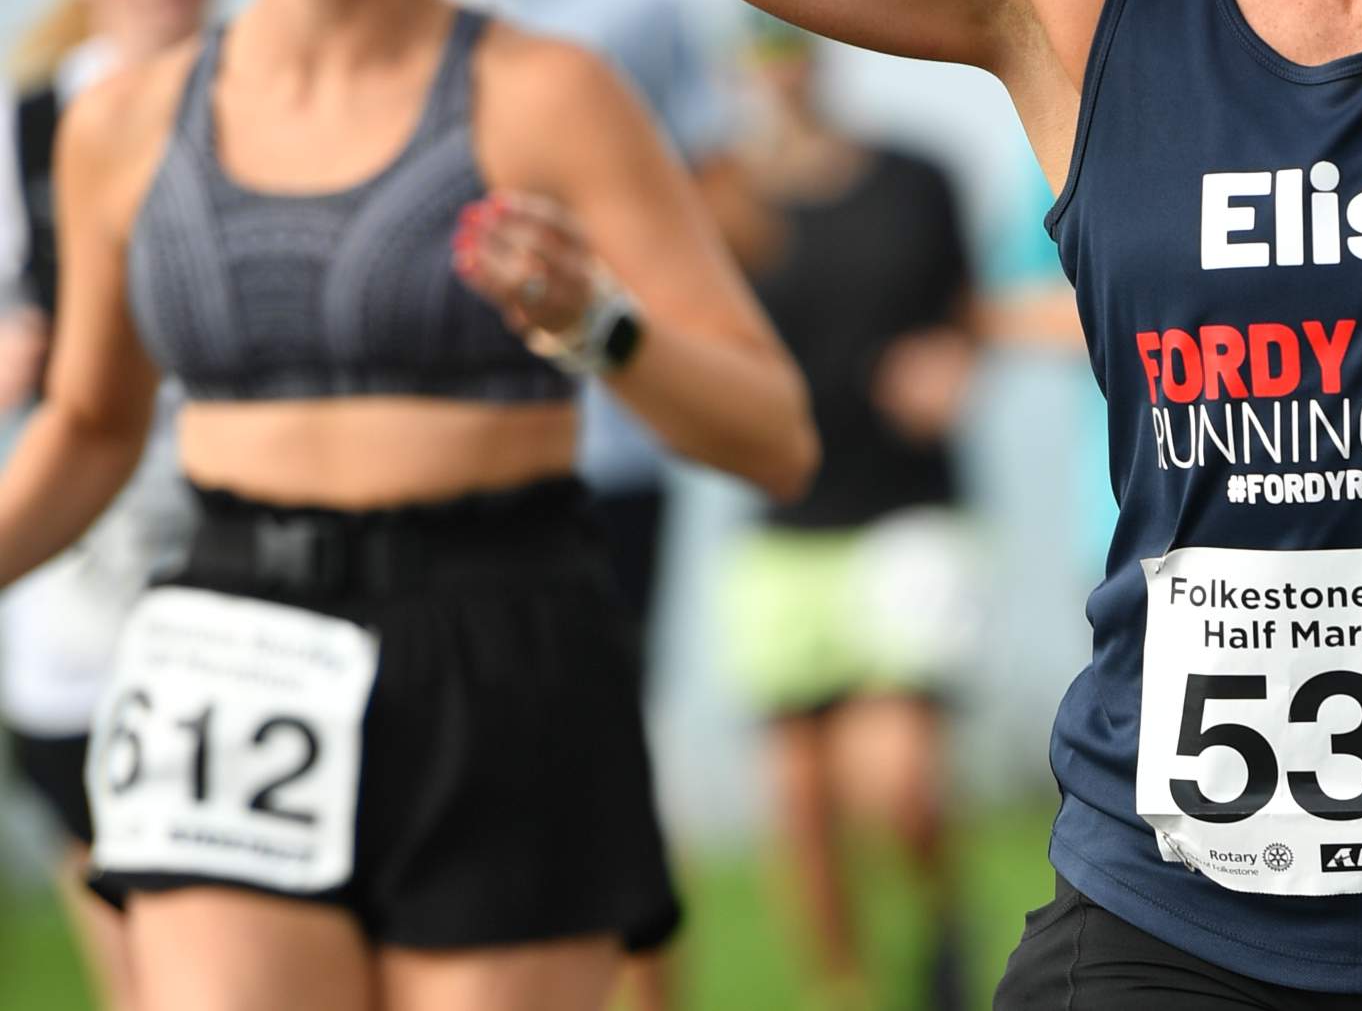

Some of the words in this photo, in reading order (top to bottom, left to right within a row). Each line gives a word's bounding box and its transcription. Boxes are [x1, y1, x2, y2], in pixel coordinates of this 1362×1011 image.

[1136, 319, 1357, 404] FORDY
[1203, 619, 1276, 650] Half
[105, 685, 321, 825] 612
[1209, 849, 1258, 866] Rotary
